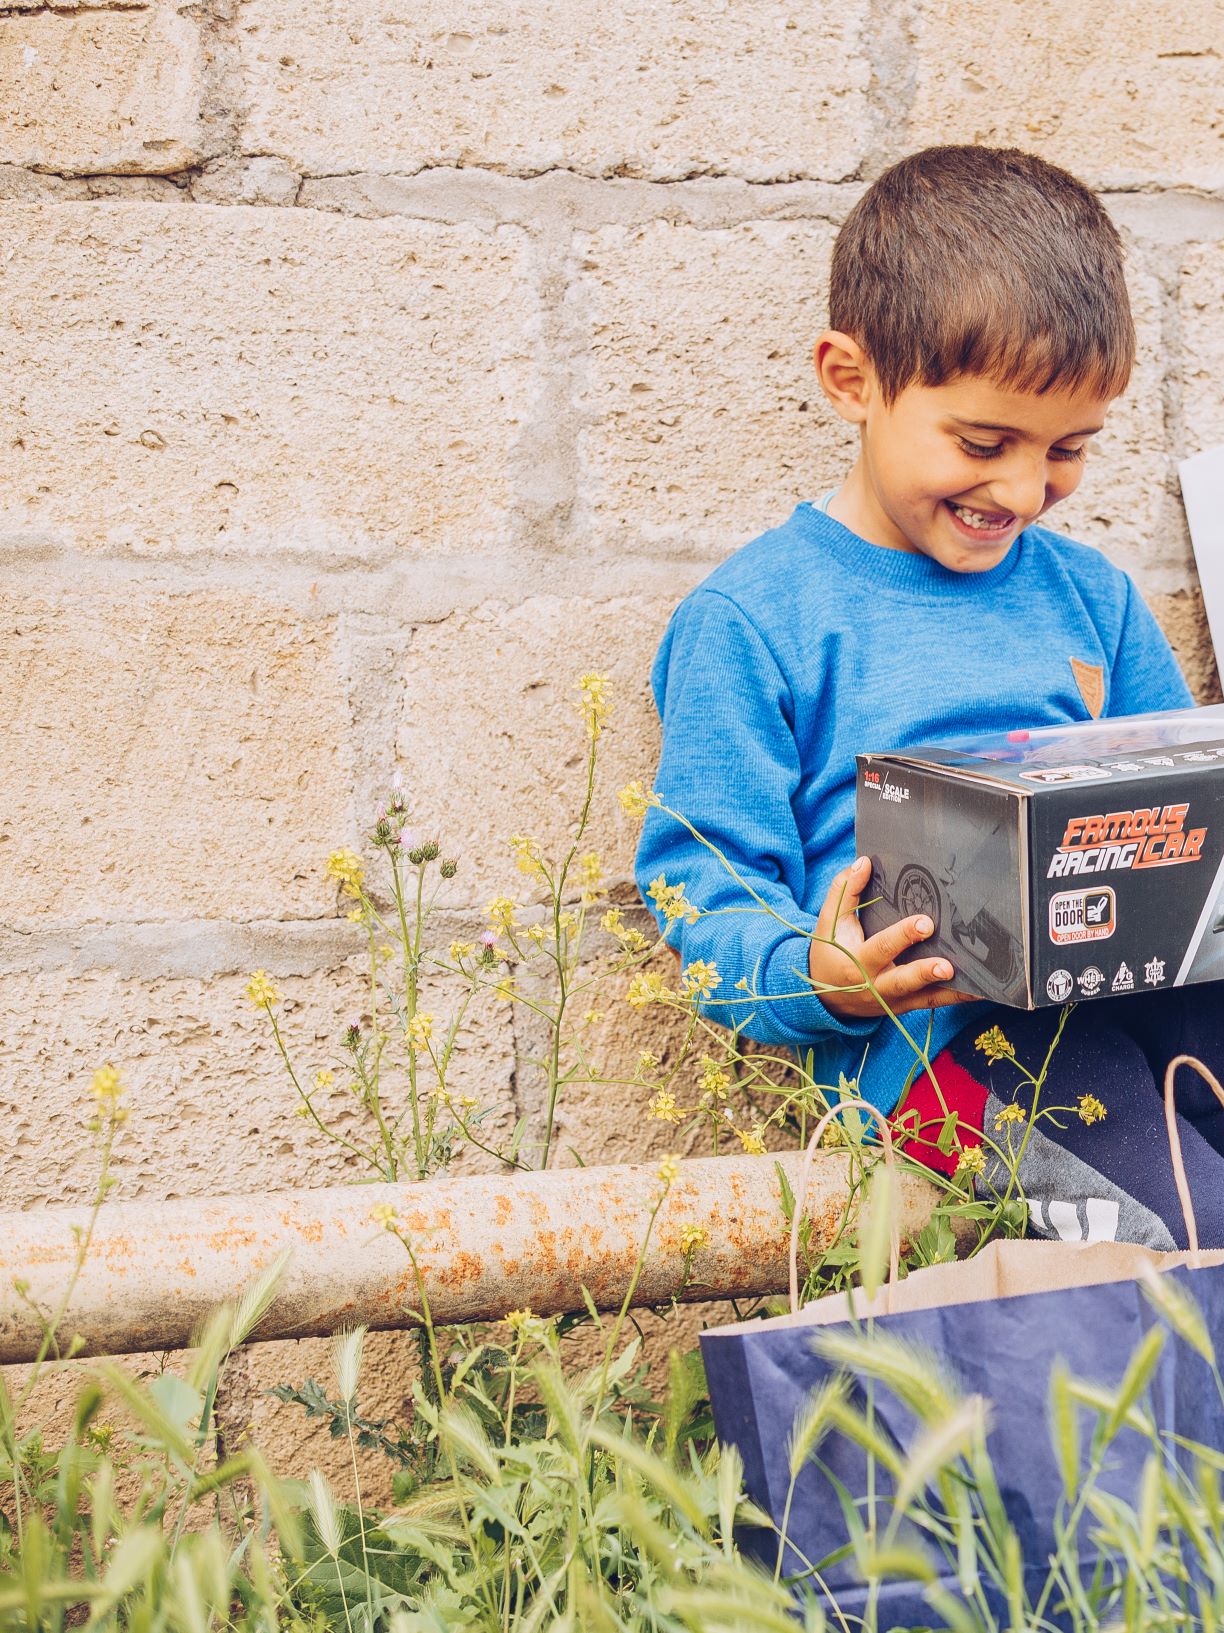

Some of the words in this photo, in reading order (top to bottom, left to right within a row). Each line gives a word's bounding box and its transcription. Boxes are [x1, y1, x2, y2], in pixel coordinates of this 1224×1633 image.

[864, 770, 880, 783] 1:16
[884, 783, 909, 800] SCALE
[1061, 803, 1190, 847] FAMOUS
[1047, 843, 1139, 878] RACING
[1141, 827, 1208, 863] CAR
[1055, 901, 1070, 910] OPEN
[1072, 898, 1082, 908] THE
[1056, 909, 1083, 927] DOOR
[1077, 973, 1105, 984] WHEEL
